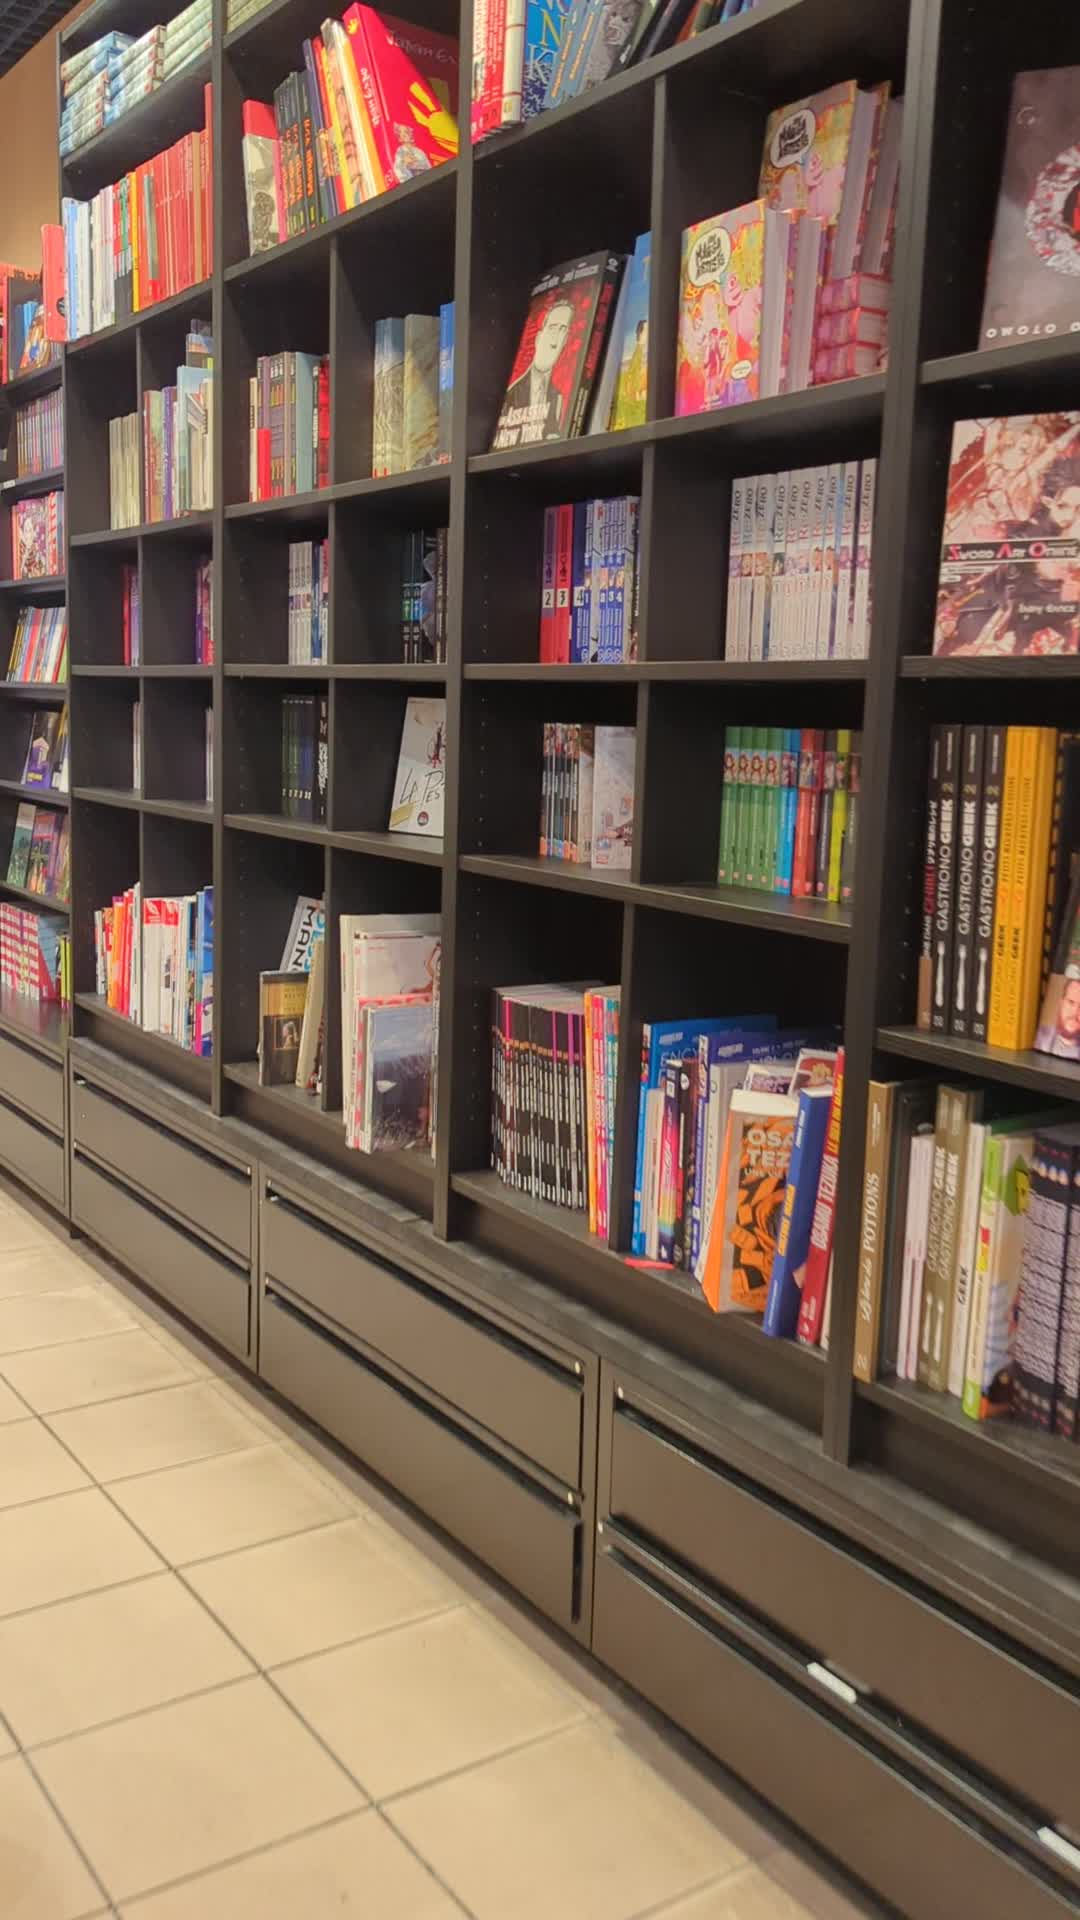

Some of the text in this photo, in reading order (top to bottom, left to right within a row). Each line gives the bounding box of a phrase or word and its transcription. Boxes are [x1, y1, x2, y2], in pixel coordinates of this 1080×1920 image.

[747, 1129, 793, 1146] OSA
[747, 1150, 789, 1168] TEZ
[863, 1172, 880, 1253] POTIONS
